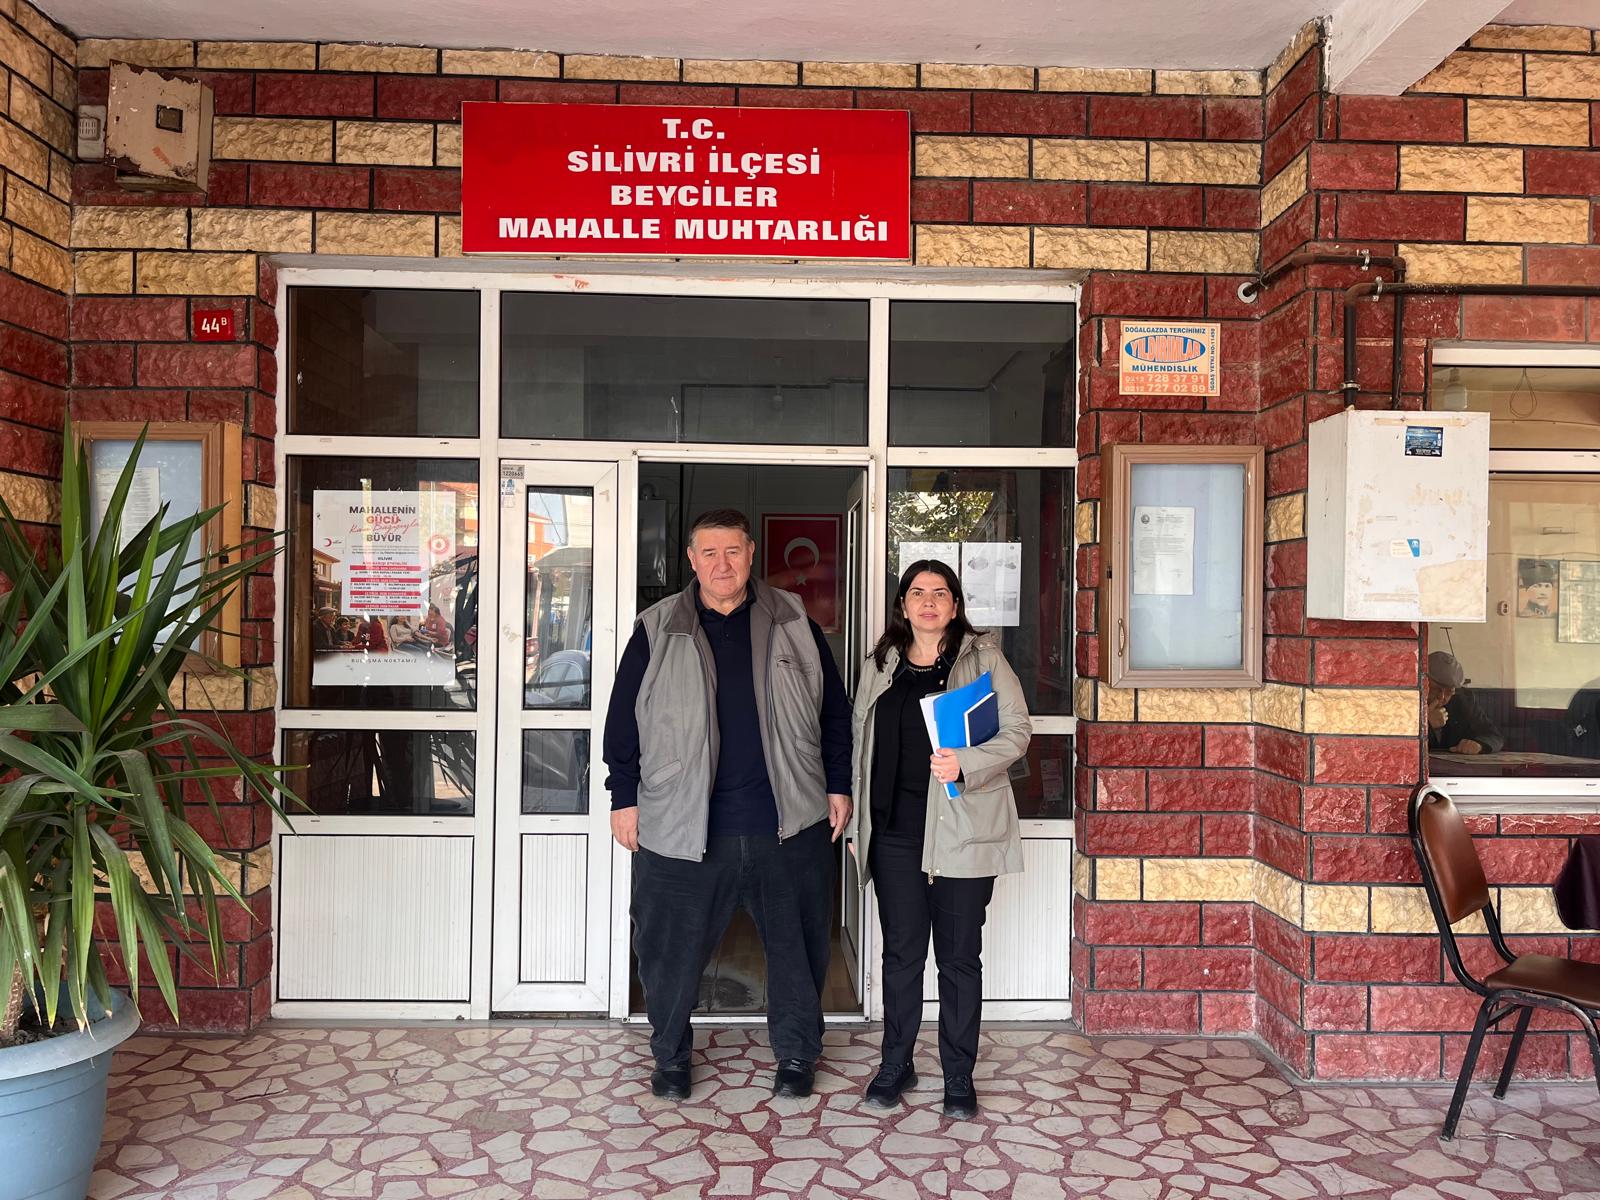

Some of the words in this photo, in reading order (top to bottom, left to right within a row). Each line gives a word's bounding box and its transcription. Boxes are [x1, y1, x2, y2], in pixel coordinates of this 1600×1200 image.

[662, 118, 725, 139] T.C.
[567, 144, 695, 173] SİLİVRİ
[709, 145, 821, 179] İLÇESİ
[611, 179, 778, 207] BEYCİLER
[499, 217, 661, 239] MAHALLE
[675, 214, 888, 242] MUHTARLIĞI
[1147, 374, 1169, 383] 728
[1173, 375, 1188, 383] 37
[1191, 375, 1205, 383] 91
[1147, 384, 1169, 392] 727
[1173, 384, 1188, 392] 02
[1191, 385, 1206, 393] 89
[349, 504, 416, 514] MAHALLENİN
[366, 514, 400, 525] GÜCÜ
[366, 532, 402, 542] BÜYÜR
